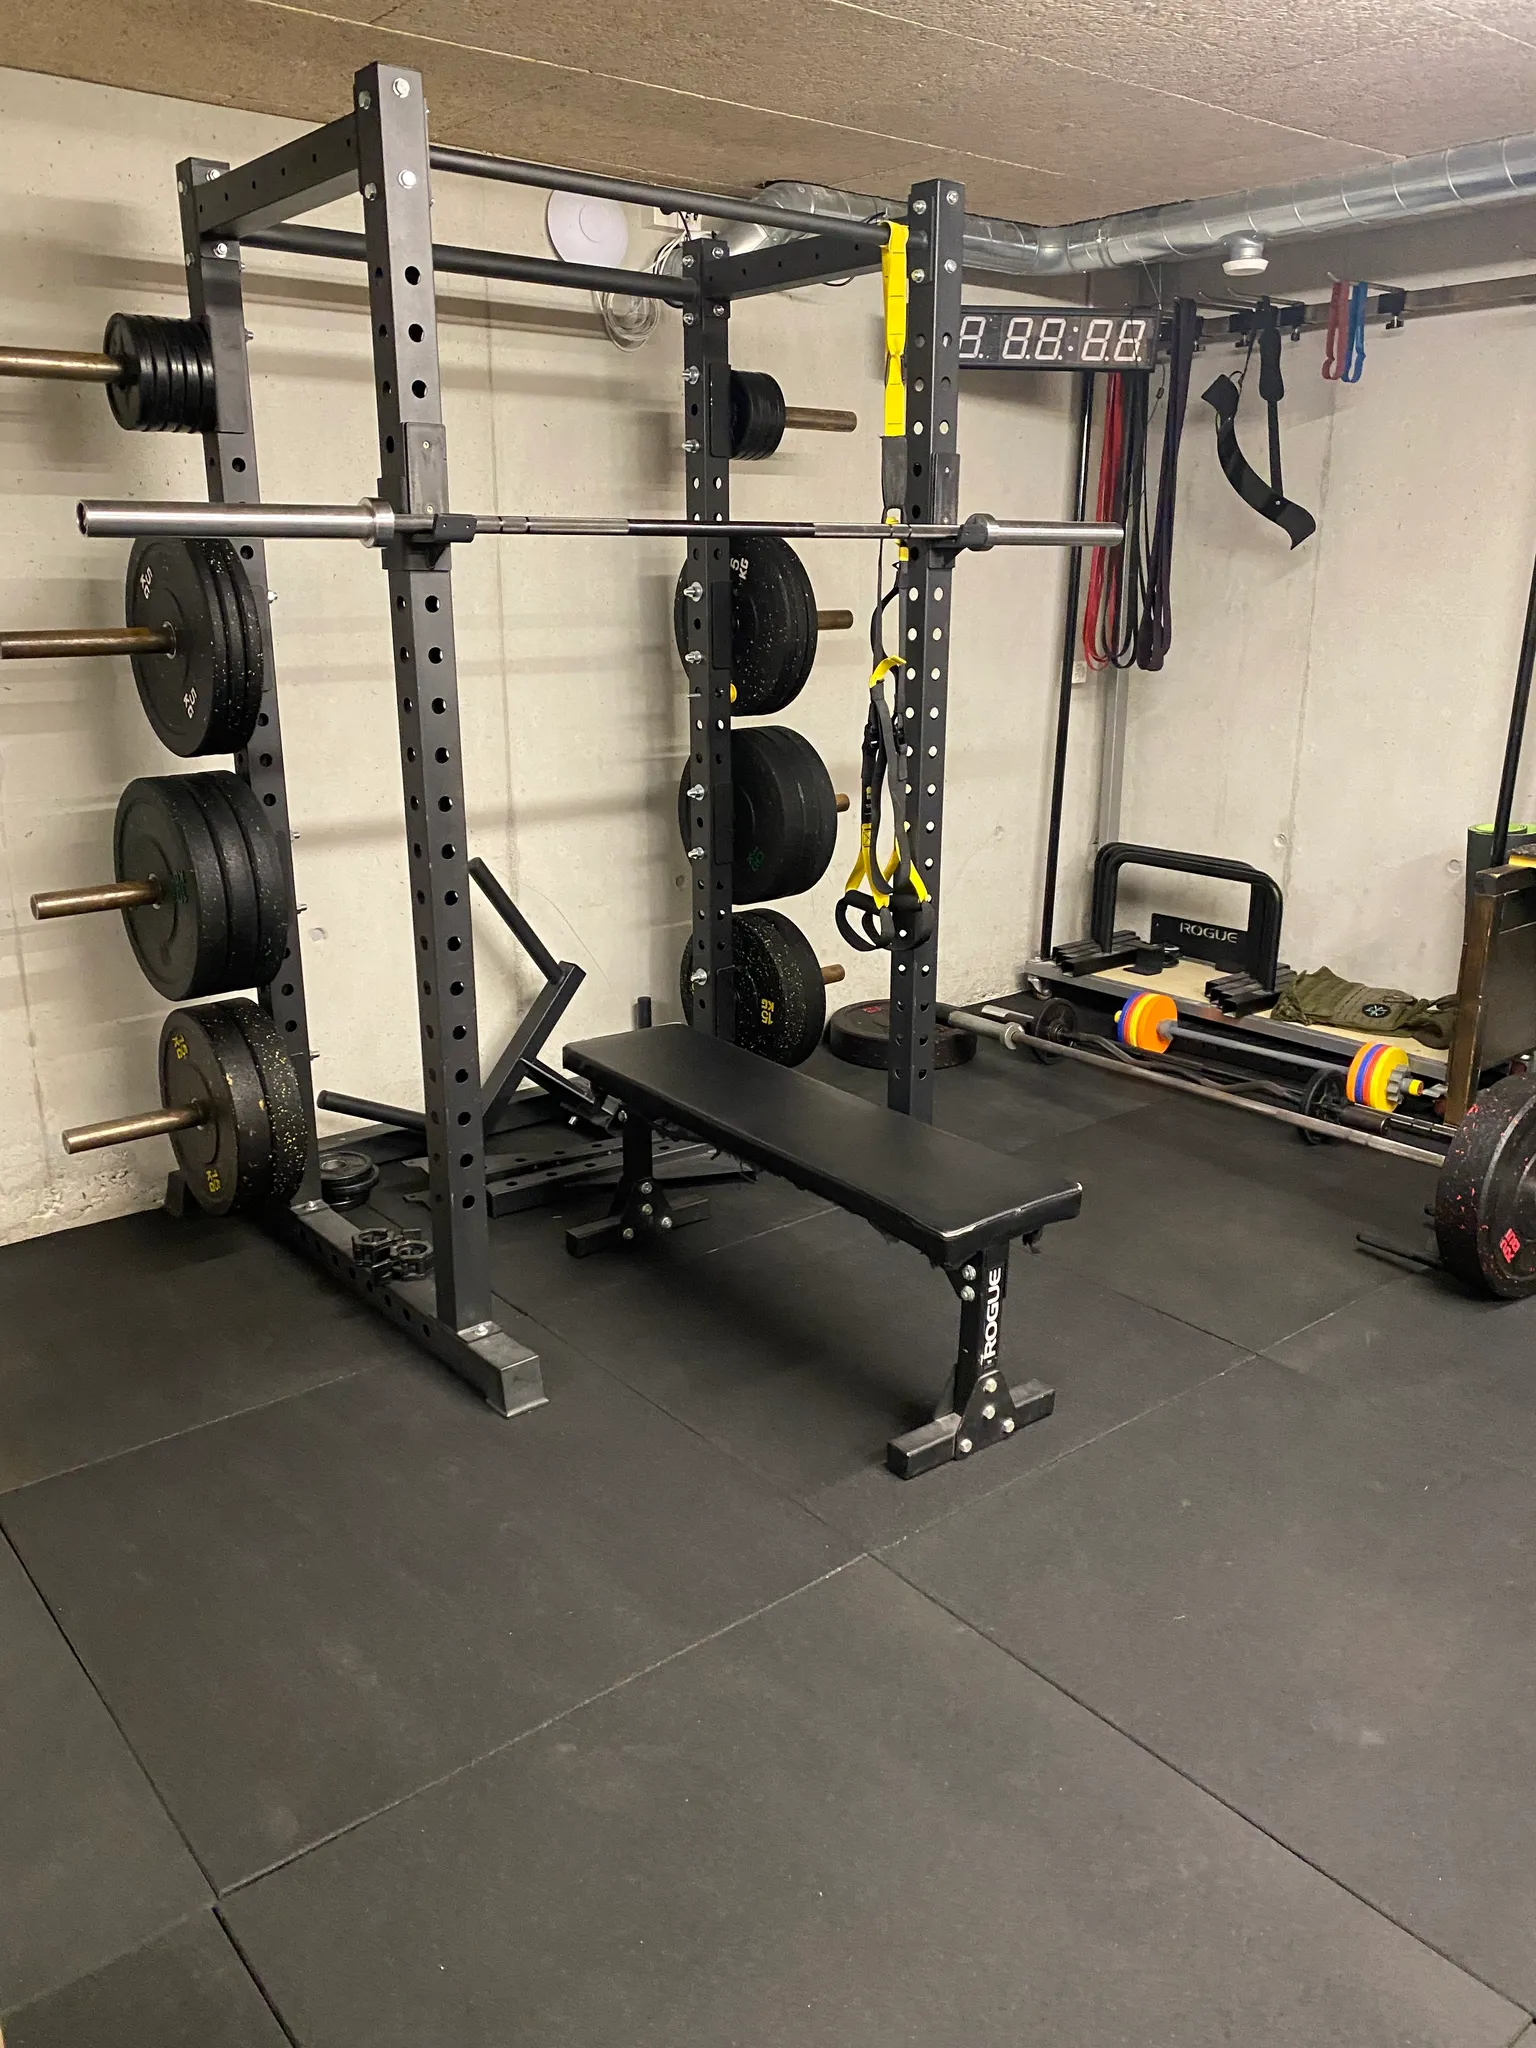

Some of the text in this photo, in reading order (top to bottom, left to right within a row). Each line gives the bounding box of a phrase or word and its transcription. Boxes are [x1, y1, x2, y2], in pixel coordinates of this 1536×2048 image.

[729, 557, 740, 571] 5
[738, 557, 749, 580] KG
[1180, 922, 1238, 943] ROGUE
[761, 998, 774, 1012] KG
[761, 1010, 773, 1025] 15
[983, 1267, 1001, 1360] ROGUE
